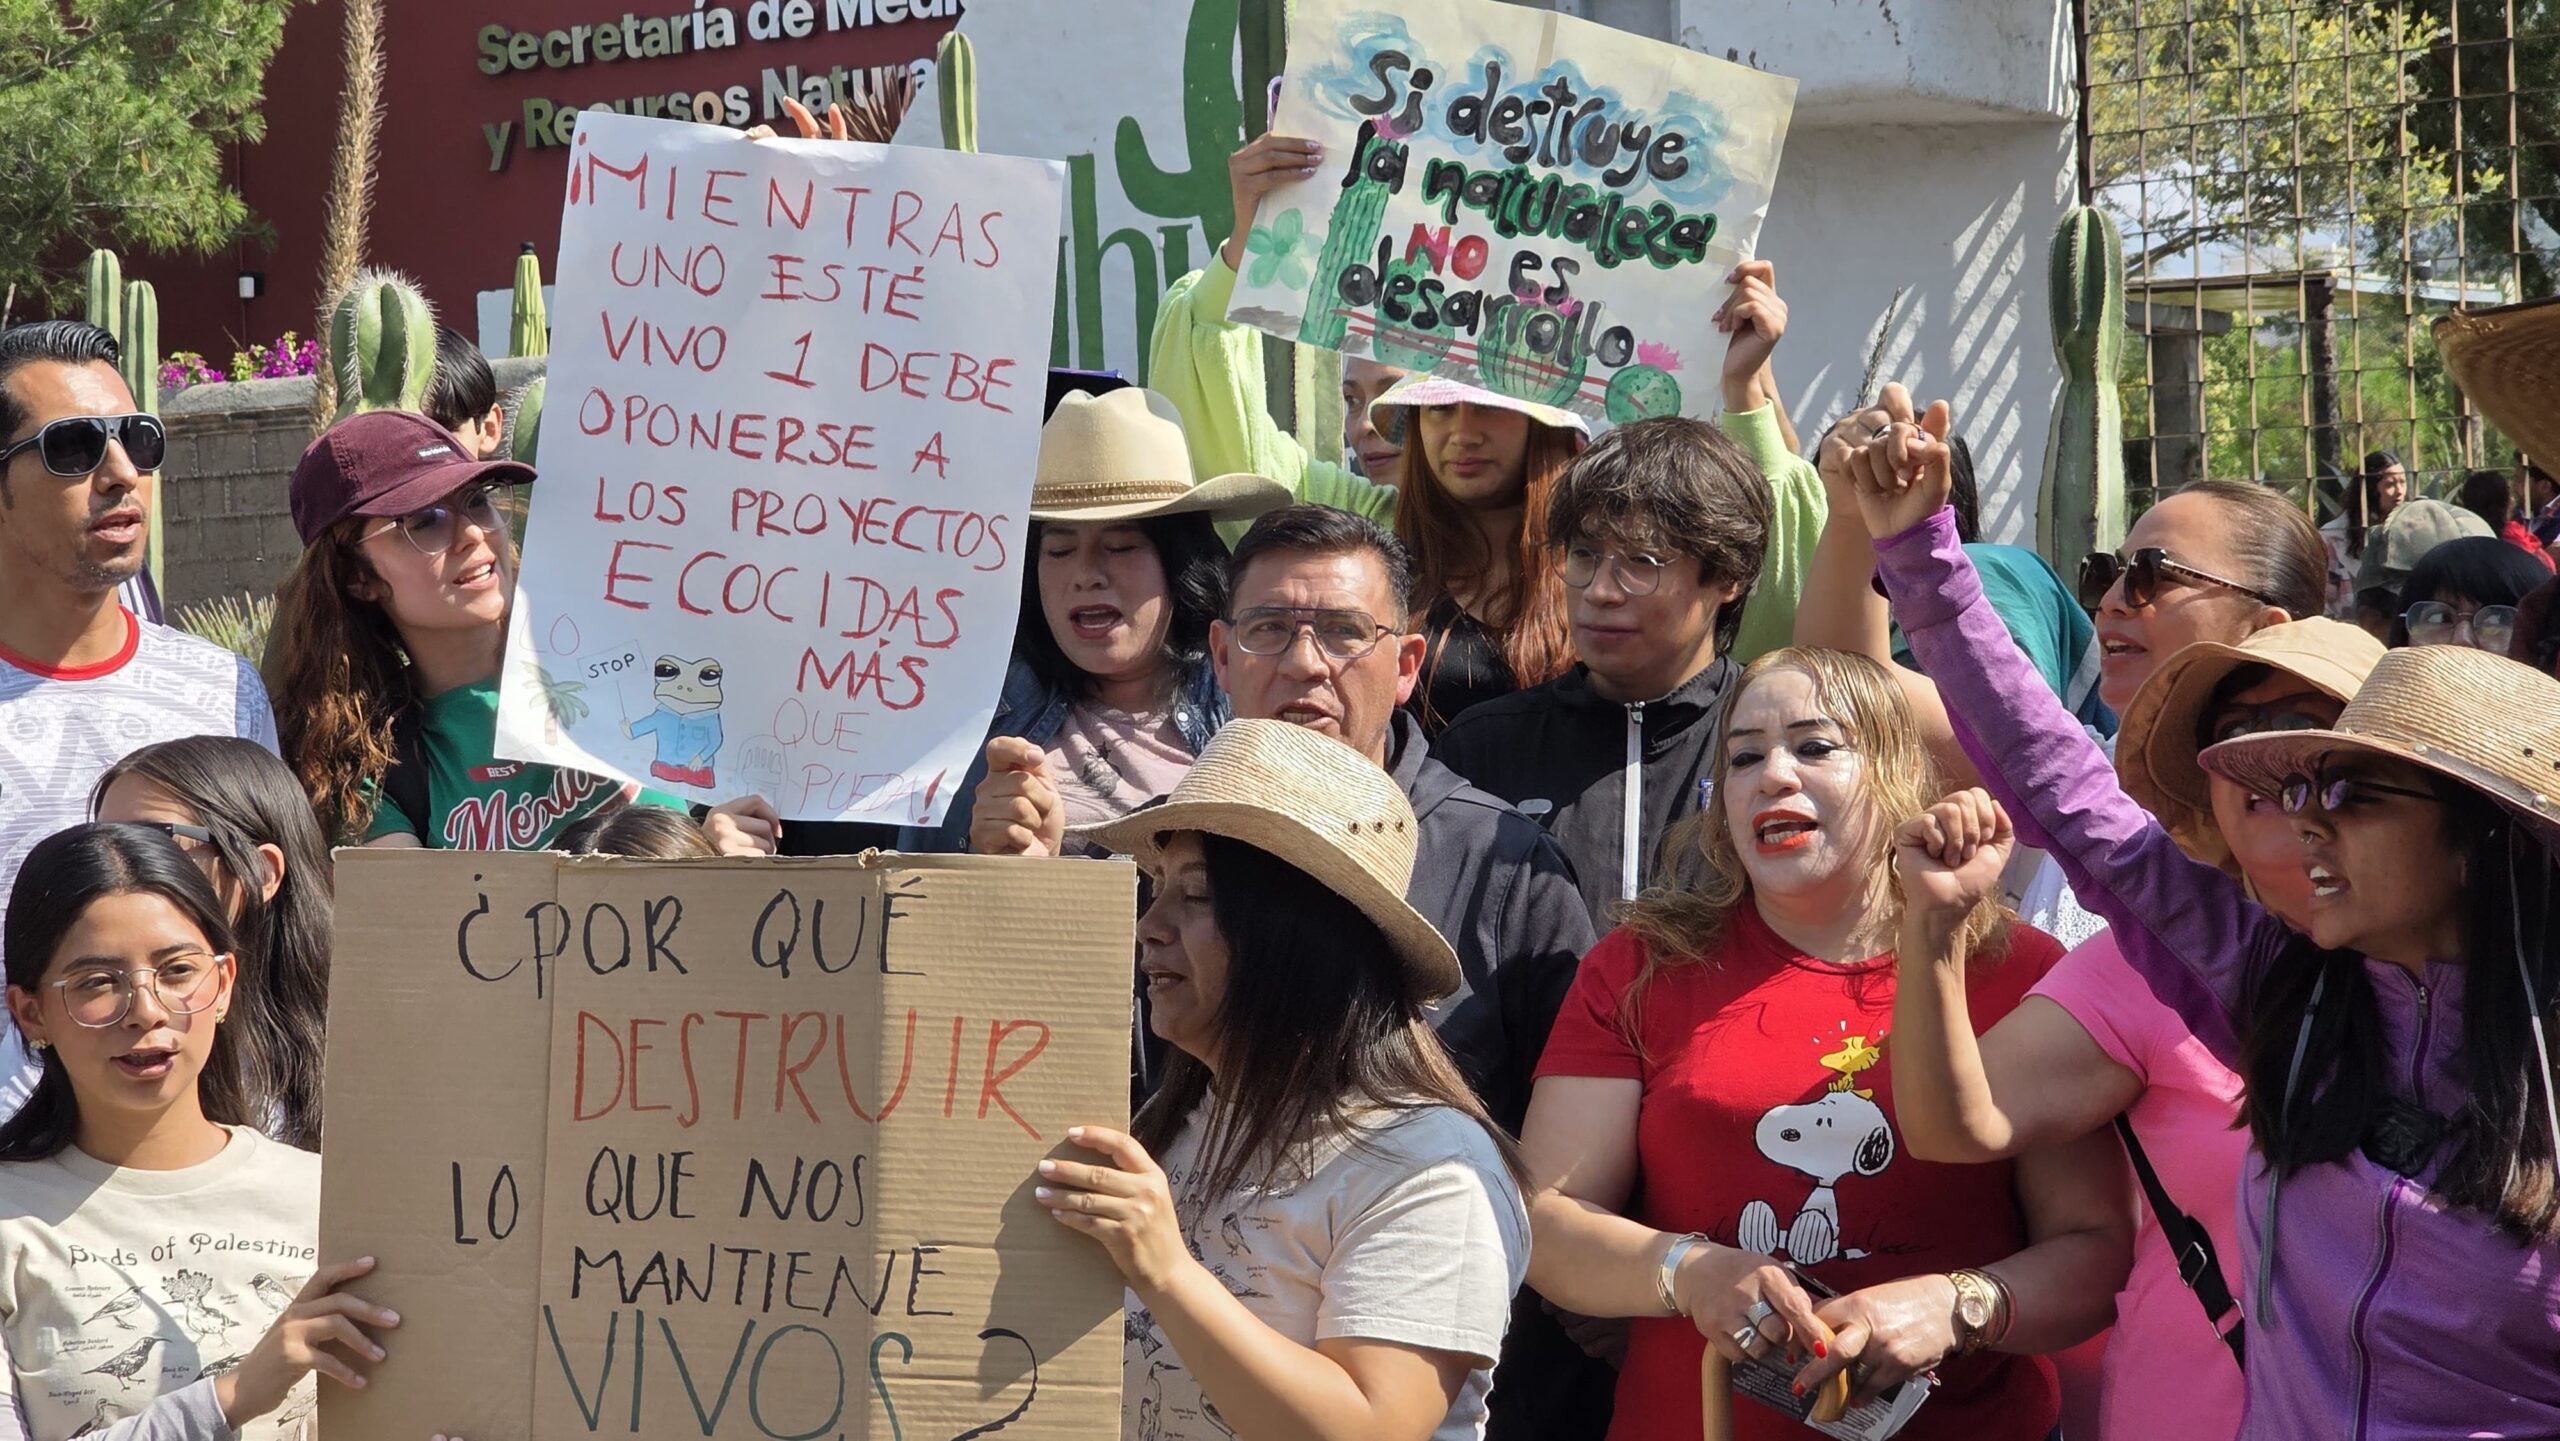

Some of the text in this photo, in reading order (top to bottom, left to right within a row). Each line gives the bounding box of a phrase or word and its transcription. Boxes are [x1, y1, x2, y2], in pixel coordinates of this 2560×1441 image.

[477, 0, 736, 75] Secretaría
[747, 0, 815, 40] de
[481, 119, 514, 172] y
[1350, 49, 1689, 188] Si destruye
[570, 131, 1003, 268] ¡MIENTRAS
[1341, 119, 1717, 269] la naturaleza
[611, 242, 926, 322] UNO ESTÉ
[1337, 236, 1634, 368] desarrollo
[1405, 222, 1580, 302] NO es
[601, 310, 727, 372] VIVO
[860, 343, 1017, 413] DEBE
[579, 387, 950, 479] OPONERSE A
[594, 477, 1010, 571] LOS PROYECTOS
[604, 539, 965, 648] ECOCIDAS
[588, 653, 635, 679] STOP
[796, 637, 930, 711] MÁS
[486, 764, 517, 778] BEST
[773, 697, 869, 753] QUE
[457, 873, 929, 1000] ¿POR QUÉ
[573, 1010, 1051, 1140] DESTRUIR
[452, 1146, 868, 1245] LO QUE NOS
[151, 1236, 176, 1262] of
[189, 1233, 316, 1260] Palestine
[571, 1243, 955, 1317] MANTIENE
